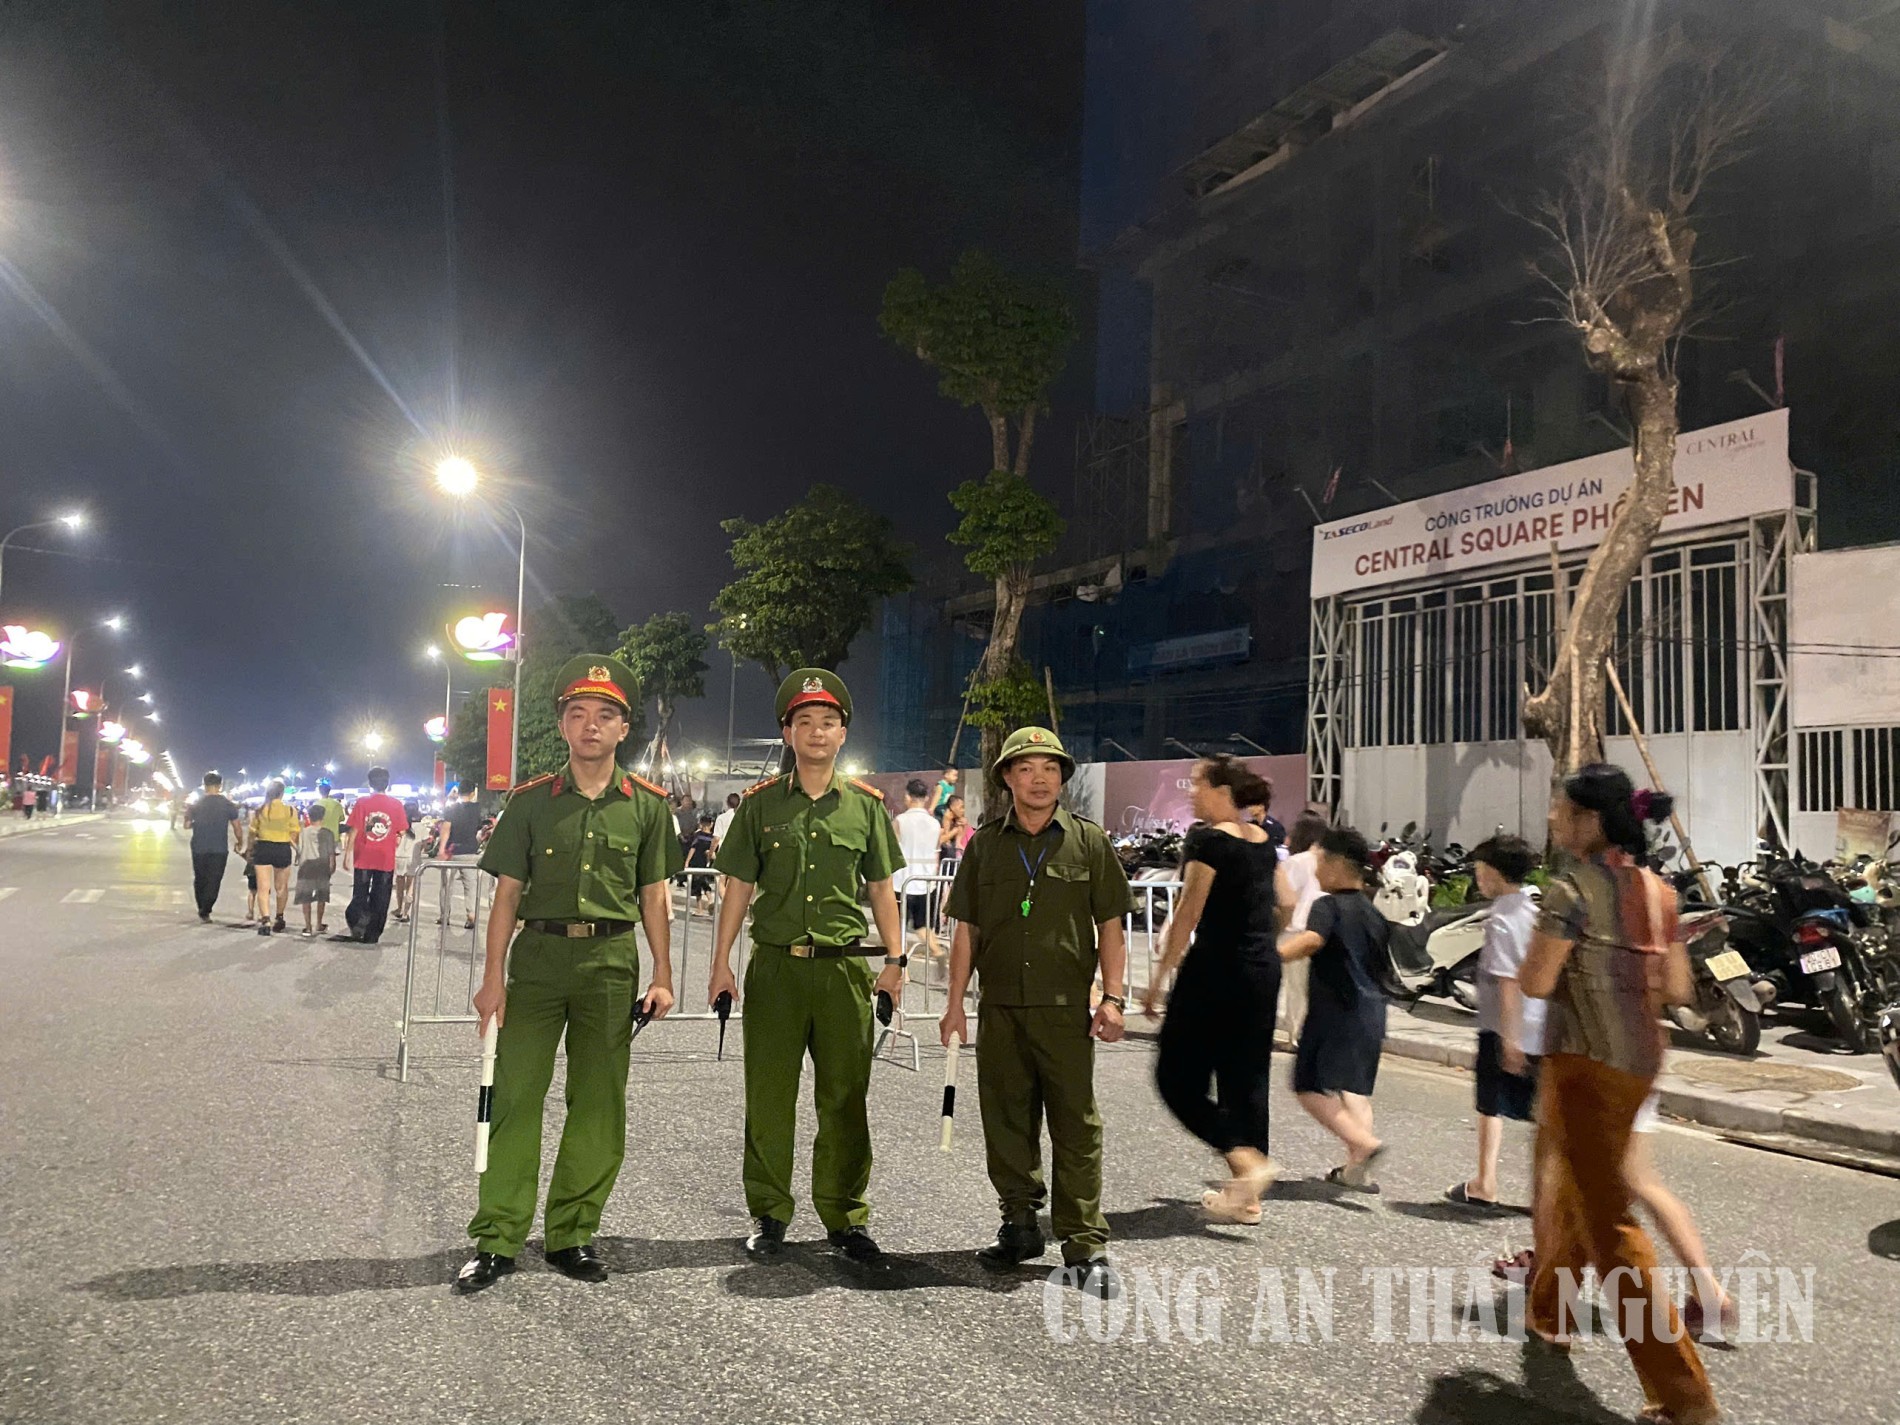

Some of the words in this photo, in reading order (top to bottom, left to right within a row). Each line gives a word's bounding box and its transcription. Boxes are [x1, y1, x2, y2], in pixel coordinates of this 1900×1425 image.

[1424, 508, 1472, 533] CÔNG
[1548, 482, 1574, 506] DỰ
[1577, 478, 1603, 496] ÁN
[1355, 537, 1454, 576] CENTRAL
[1461, 512, 1565, 556] SQUARE
